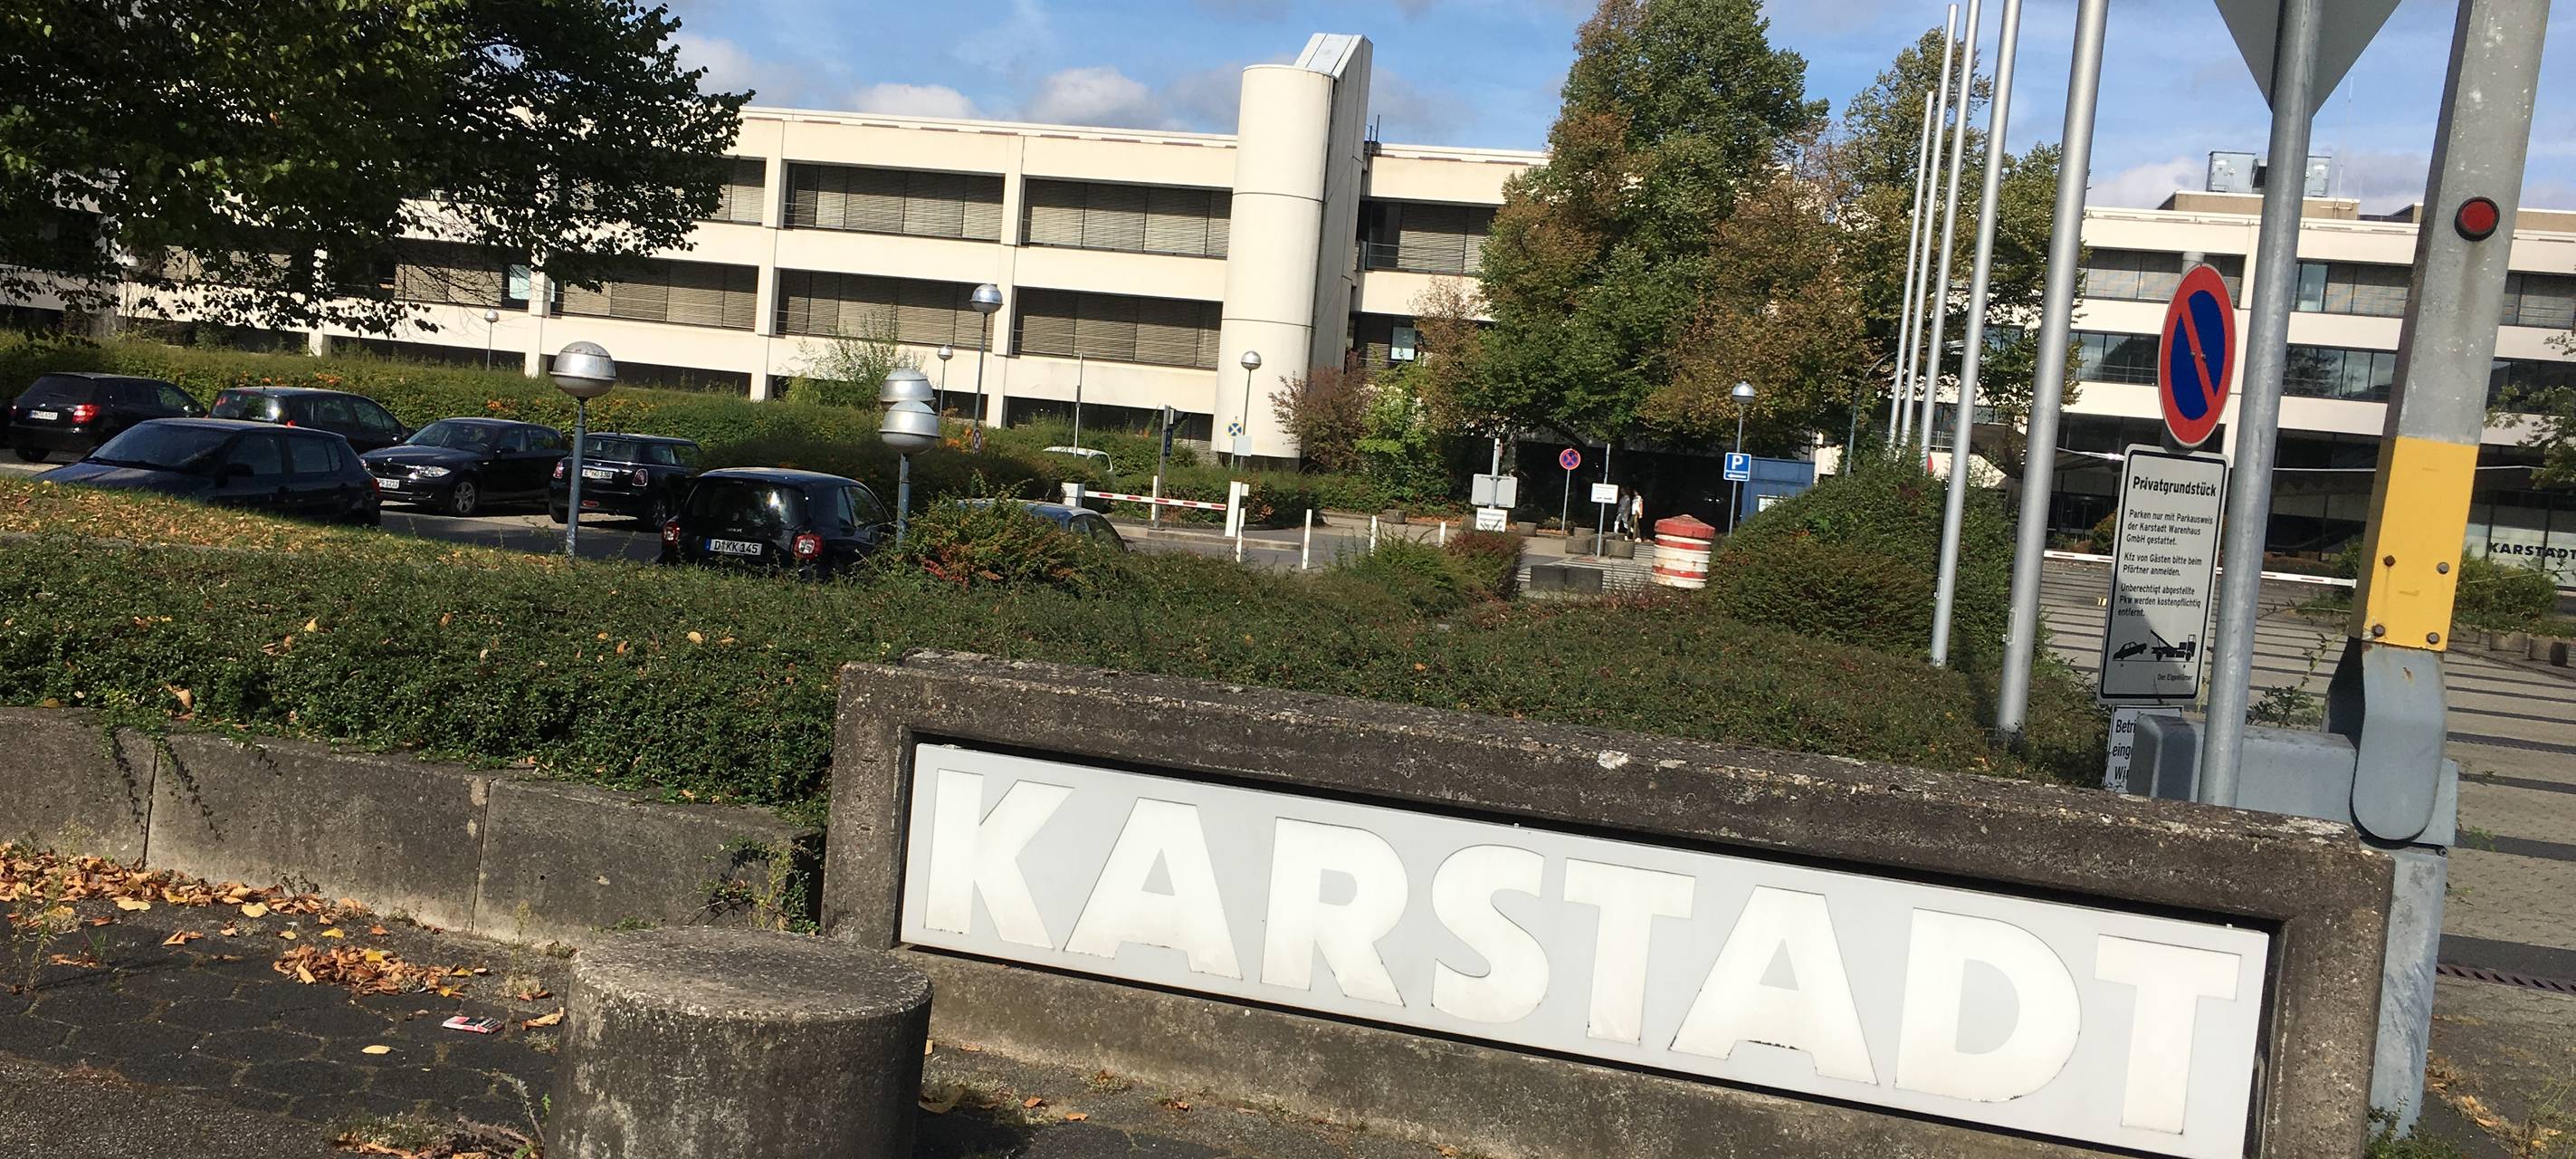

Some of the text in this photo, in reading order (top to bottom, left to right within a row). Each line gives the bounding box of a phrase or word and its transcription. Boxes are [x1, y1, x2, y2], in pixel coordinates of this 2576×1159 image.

[1732, 455, 1743, 470] P
[2132, 475, 2217, 497] Privatgrundstück
[2129, 509, 2151, 519] Parken
[2164, 512, 2175, 522] mit
[2176, 512, 2213, 524] Parkausweis
[2127, 522, 2201, 535] der Karstadt Warenhaus
[2126, 533, 2177, 546] GmbH gestattet.
[714, 541, 758, 554] D KK 145
[2489, 541, 2576, 560] KARSTADT
[2124, 552, 2202, 565] Kfz von Gästen bitte beim
[2123, 564, 2180, 576] Pförtner anmelden.
[2121, 583, 2195, 596] Unberechtigt abgestellte
[2119, 595, 2200, 608] Pkw werden kostenpflichtig
[2118, 608, 2145, 617] entfernt.
[924, 768, 2242, 1135] KARSTADT
